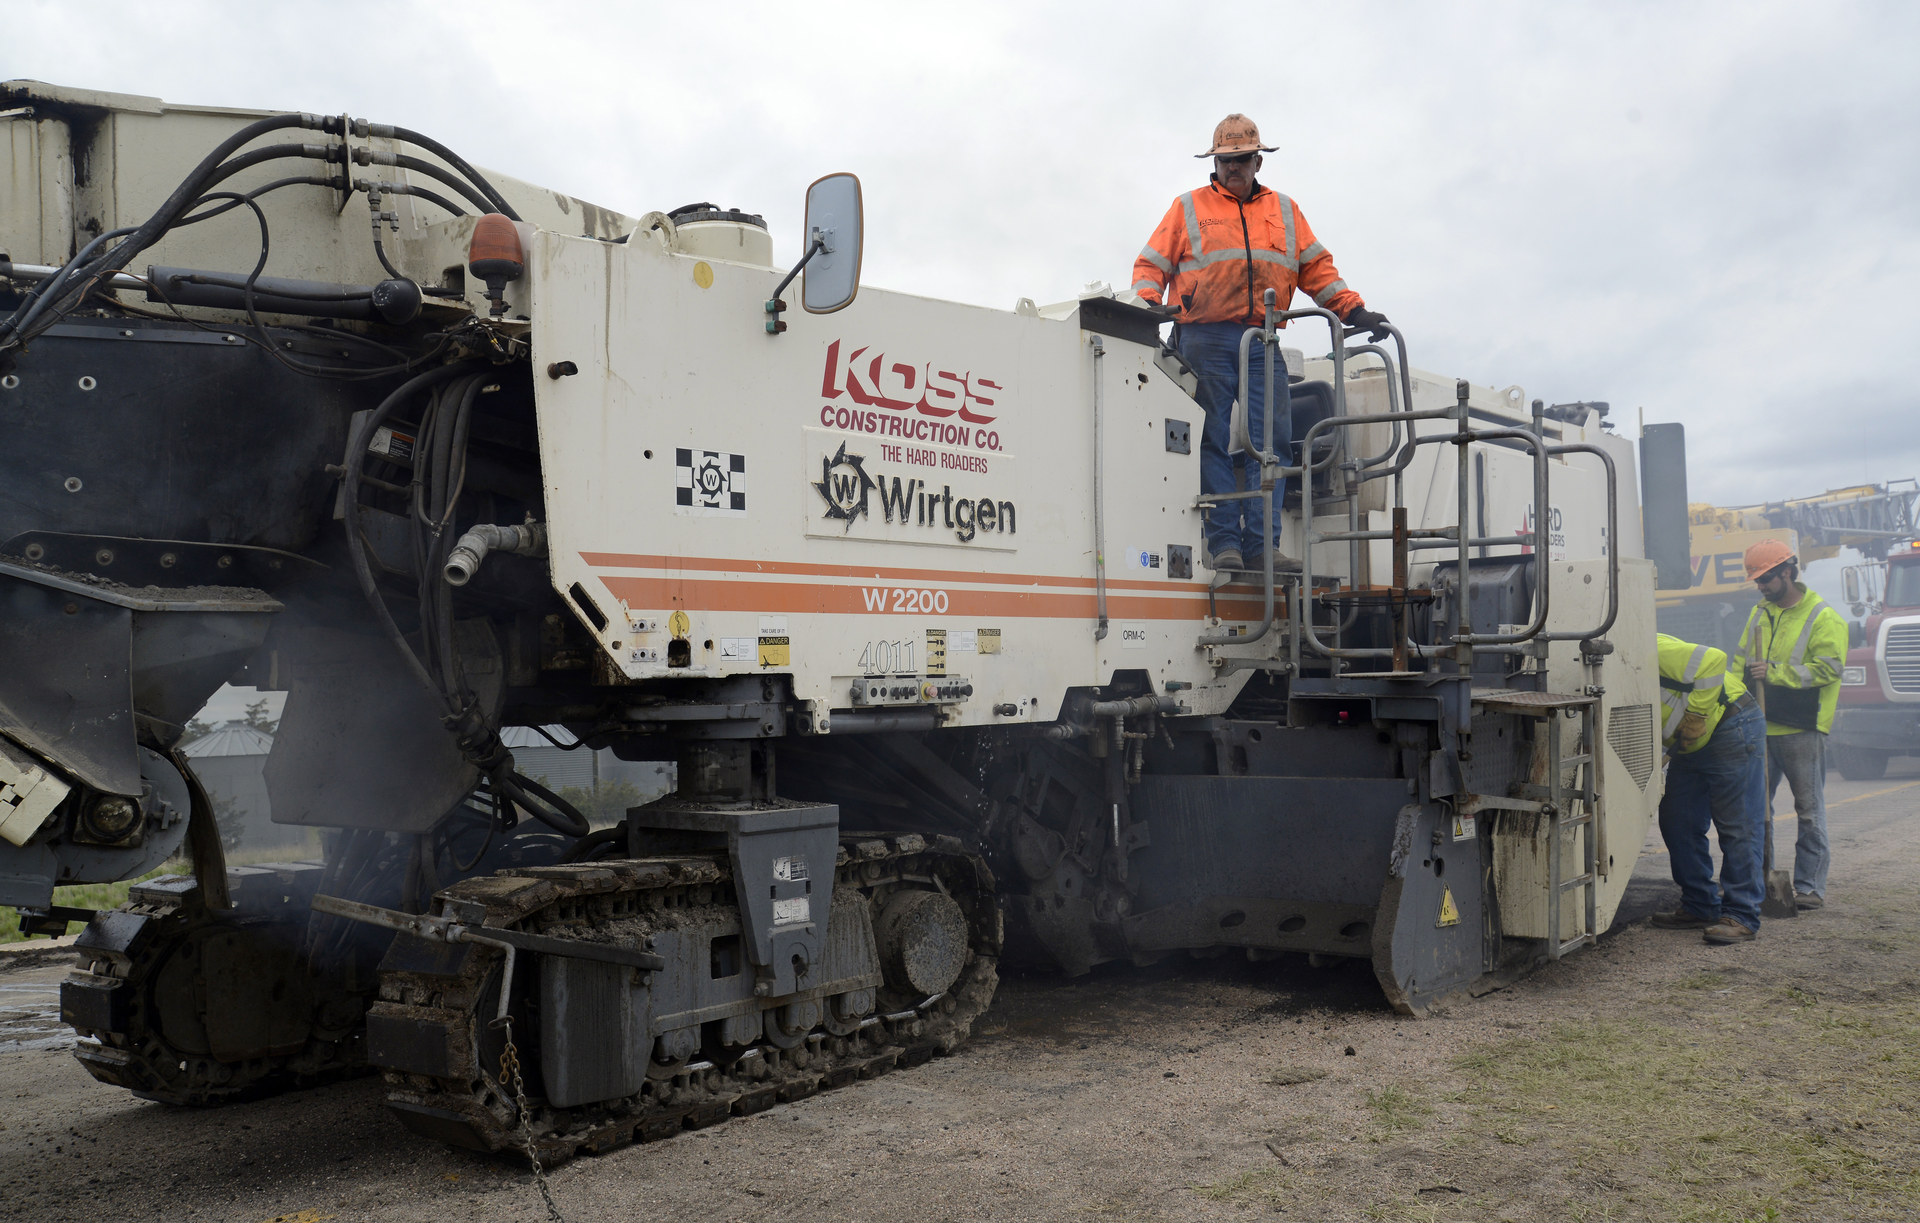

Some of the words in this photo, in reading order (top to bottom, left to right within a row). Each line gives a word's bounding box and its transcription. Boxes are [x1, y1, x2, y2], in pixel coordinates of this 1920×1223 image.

[821, 338, 1003, 425] KOSS
[820, 405, 970, 446] CONSTRUCTION
[975, 429, 1003, 452] CO.
[881, 444, 902, 463] THE
[906, 447, 937, 467] HARD
[941, 452, 988, 474] ROADERS
[705, 473, 717, 487] W
[876, 474, 1016, 543] Wirtgen
[1528, 504, 1563, 532] HRD
[861, 587, 889, 612] W
[892, 588, 949, 614] 2200
[1122, 629, 1146, 641] ORM-C
[857, 639, 919, 675] 4011
